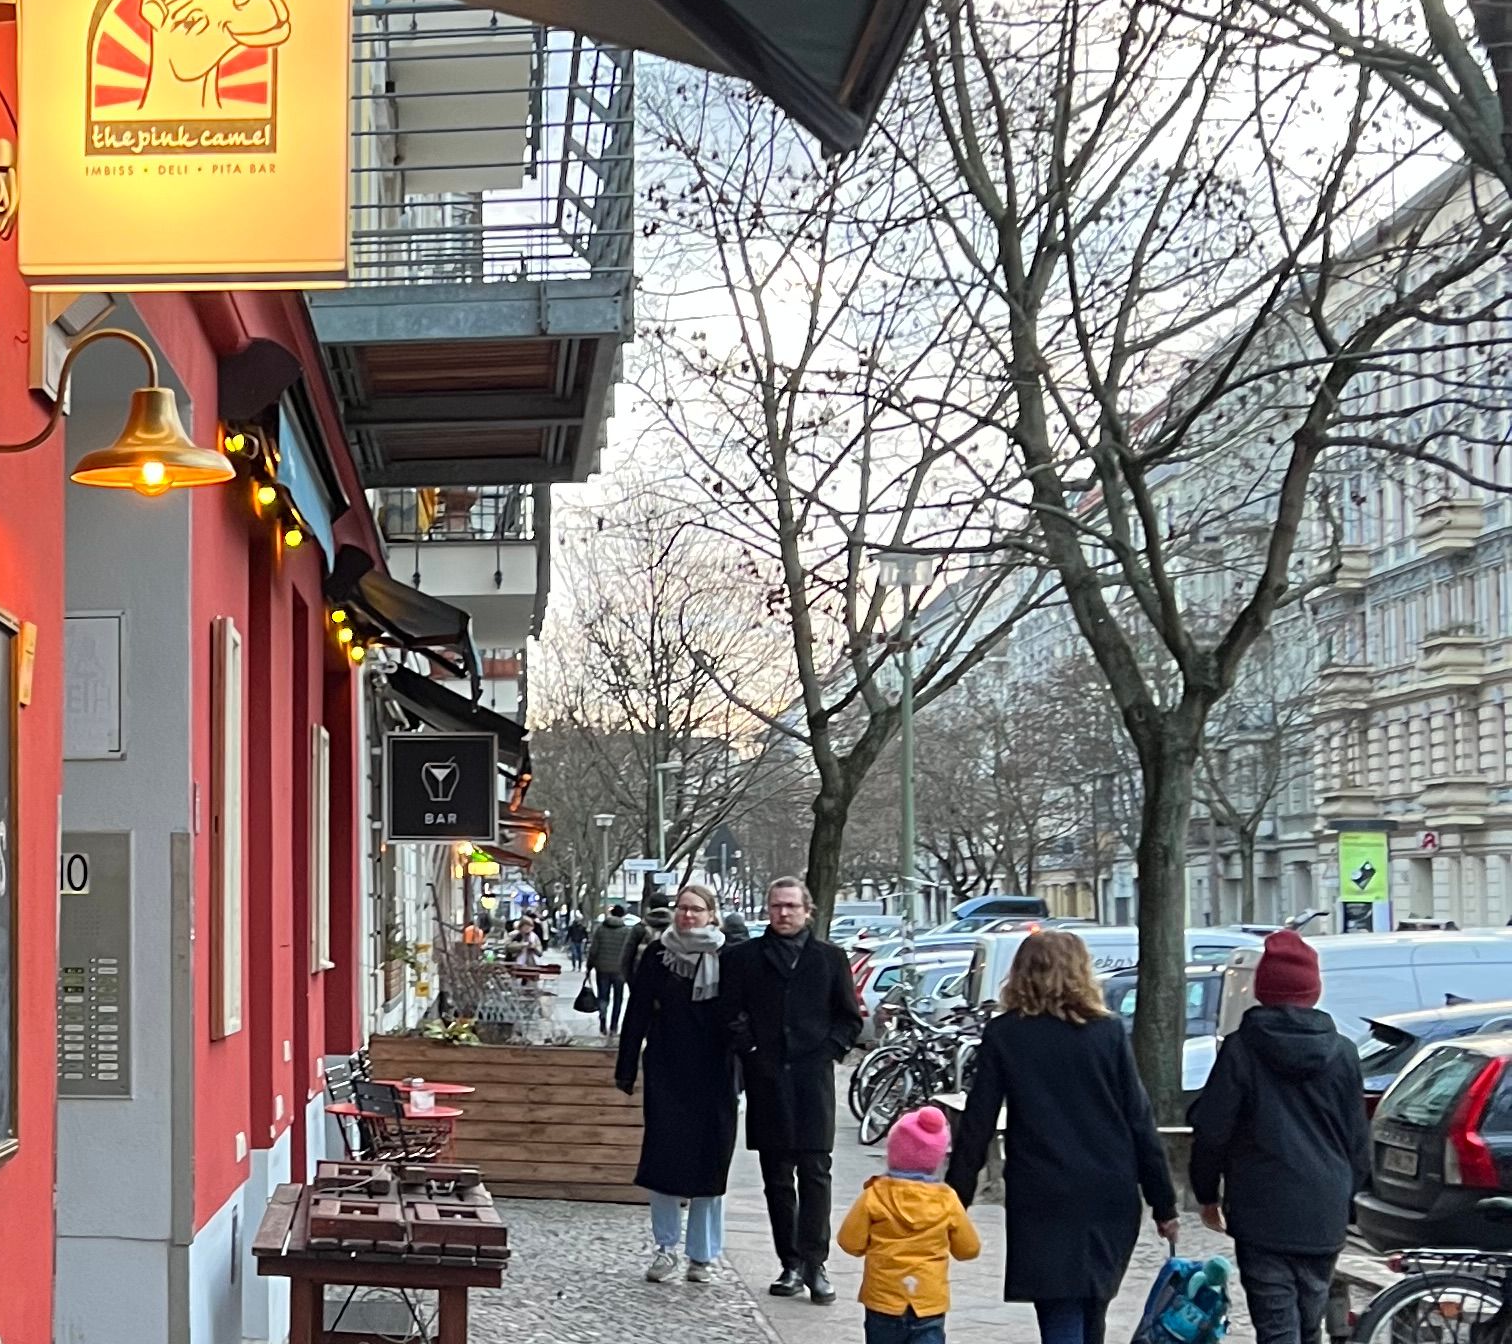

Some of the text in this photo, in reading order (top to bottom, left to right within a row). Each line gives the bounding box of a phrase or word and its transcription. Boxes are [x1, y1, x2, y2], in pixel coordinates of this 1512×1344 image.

[91, 124, 272, 153] the pink camel
[85, 162, 277, 177] IMBISS DELI PITA BAR
[424, 812, 457, 825] BAR
